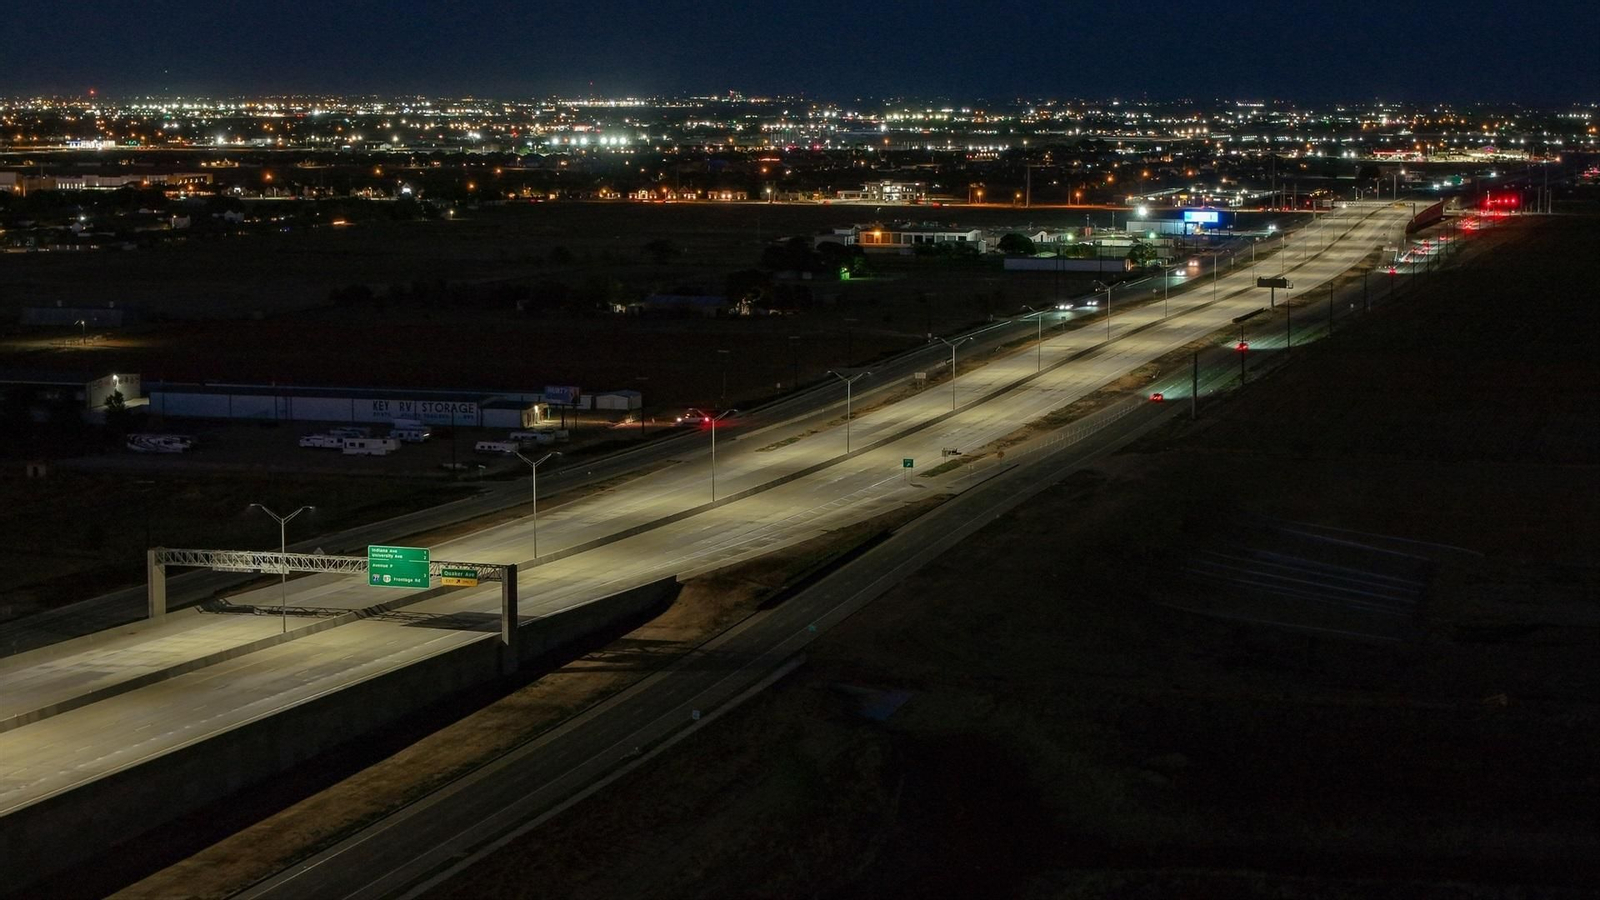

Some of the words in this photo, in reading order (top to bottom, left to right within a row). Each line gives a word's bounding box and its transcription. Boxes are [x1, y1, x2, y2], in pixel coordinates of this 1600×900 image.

[372, 400, 389, 411] KEY
[399, 401, 412, 412] RV
[421, 402, 474, 414] STORAGE
